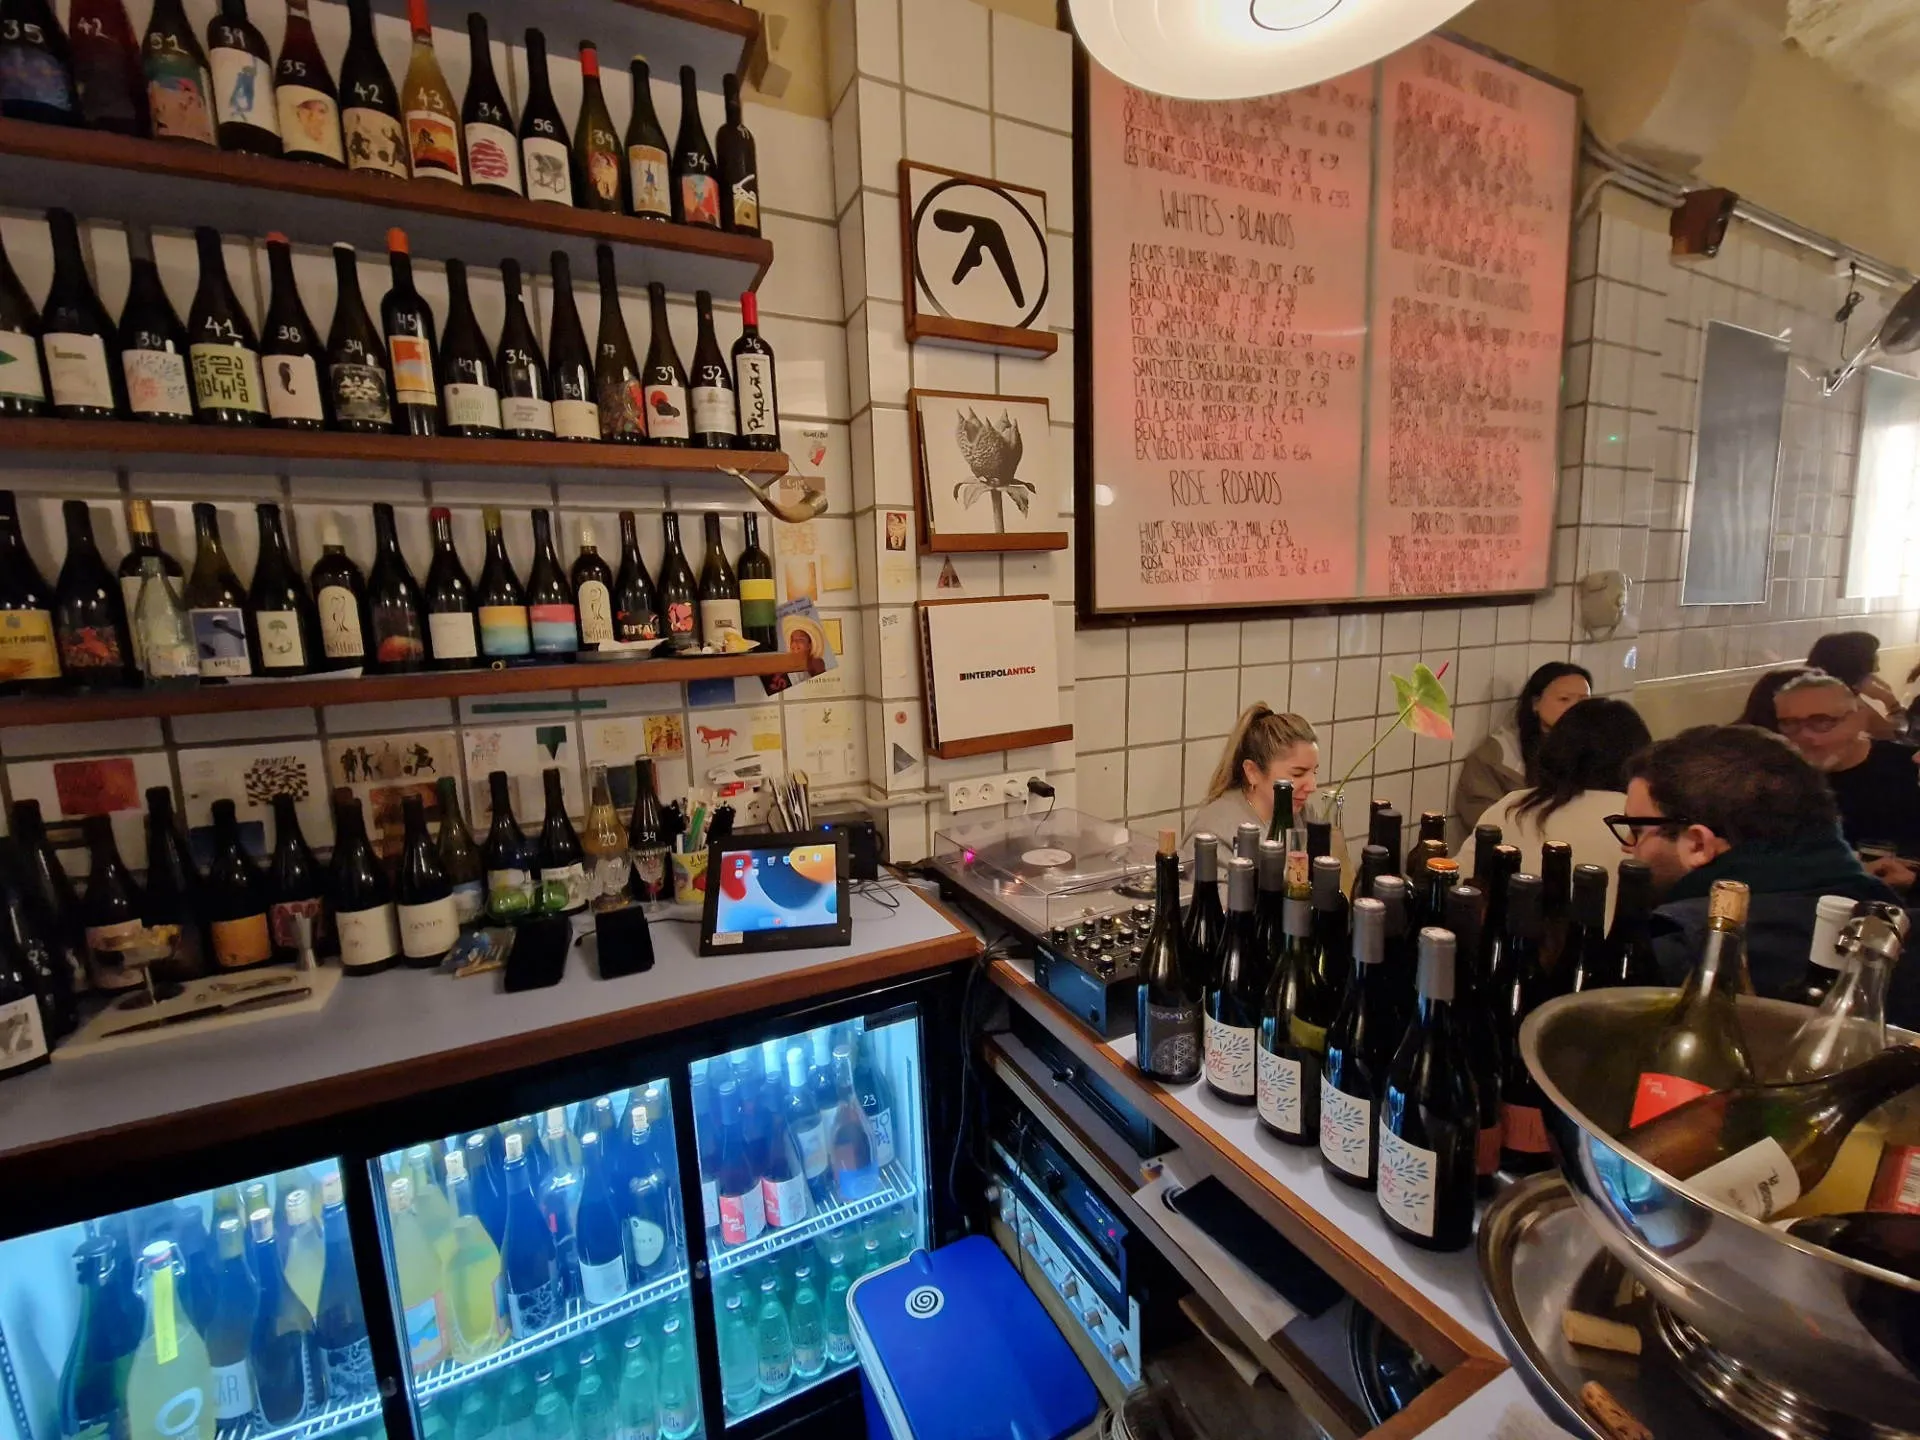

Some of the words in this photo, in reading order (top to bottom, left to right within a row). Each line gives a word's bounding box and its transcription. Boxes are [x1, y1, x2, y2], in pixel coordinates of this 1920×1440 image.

[3, 19, 44, 44] 35
[282, 59, 307, 77] 35
[354, 81, 384, 104] 42
[479, 102, 501, 121] 34
[533, 118, 554, 134] 56
[593, 129, 614, 148] 39
[687, 151, 709, 171] 34
[1160, 189, 1225, 237] WHITES
[1237, 203, 1296, 250] BLANCOS
[205, 316, 243, 339] 41
[277, 325, 301, 342] 38
[746, 338, 760, 349] 36
[702, 365, 724, 382] 32
[1170, 470, 1212, 507] ROSE
[1221, 469, 1283, 505] ROSADOS
[642, 831, 657, 843] 34
[863, 1094, 876, 1107] 23
